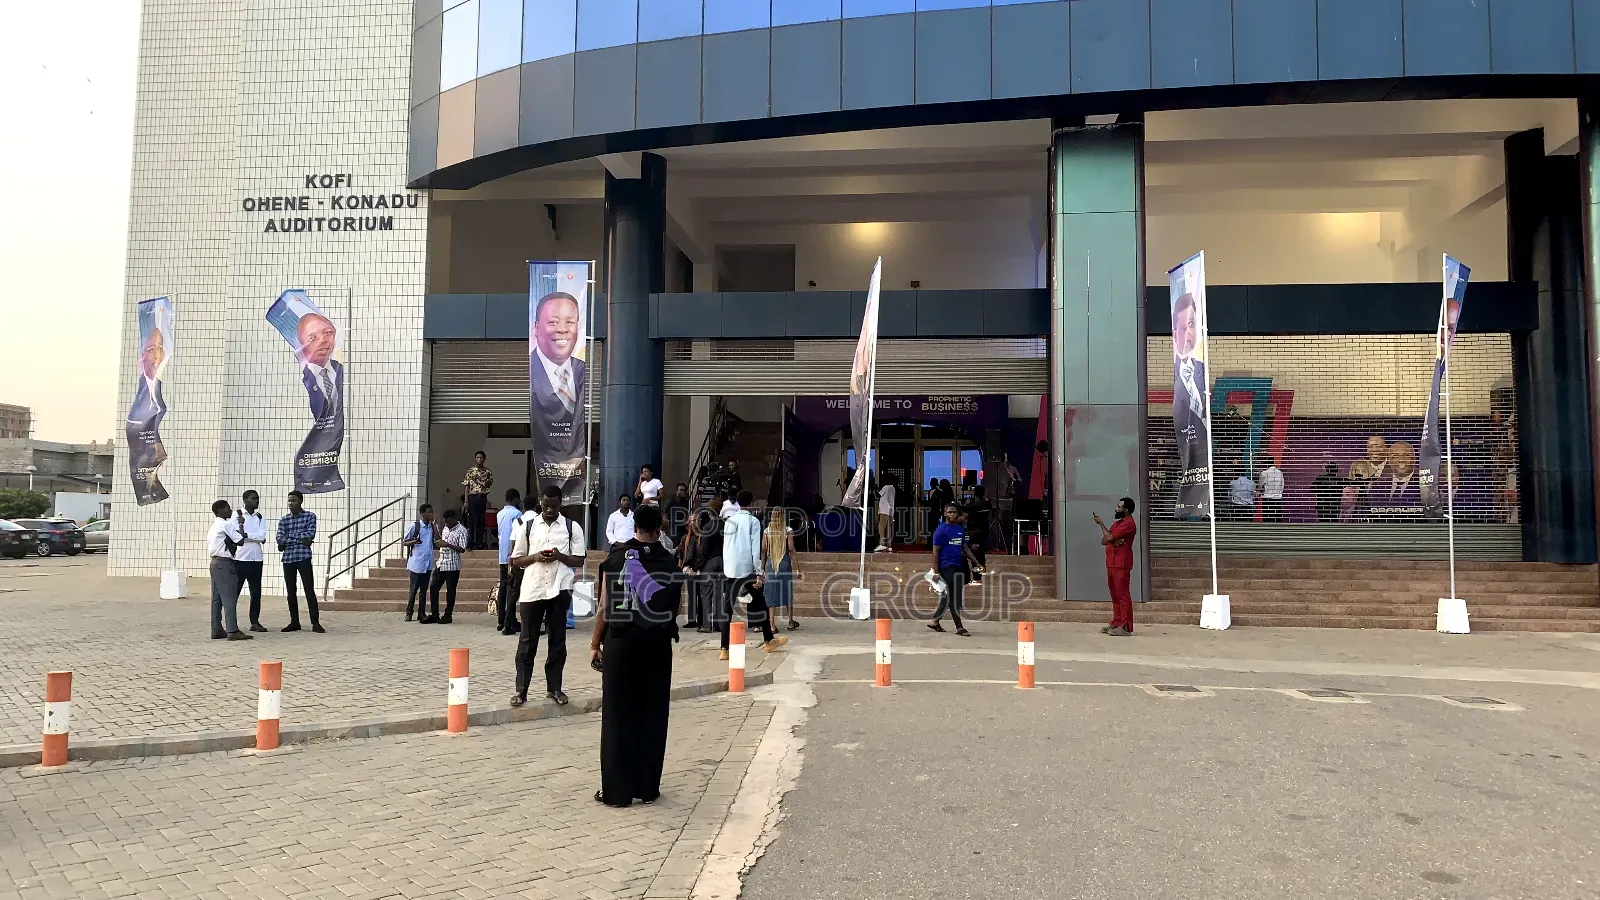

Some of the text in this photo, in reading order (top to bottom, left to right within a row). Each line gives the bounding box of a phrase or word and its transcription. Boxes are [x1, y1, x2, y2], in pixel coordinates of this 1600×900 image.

[305, 173, 352, 189] KOFI
[242, 196, 310, 212] OHENE
[331, 193, 419, 210] KONADU
[264, 216, 394, 233] AUDITORIUM
[826, 399, 912, 409] WELME TO
